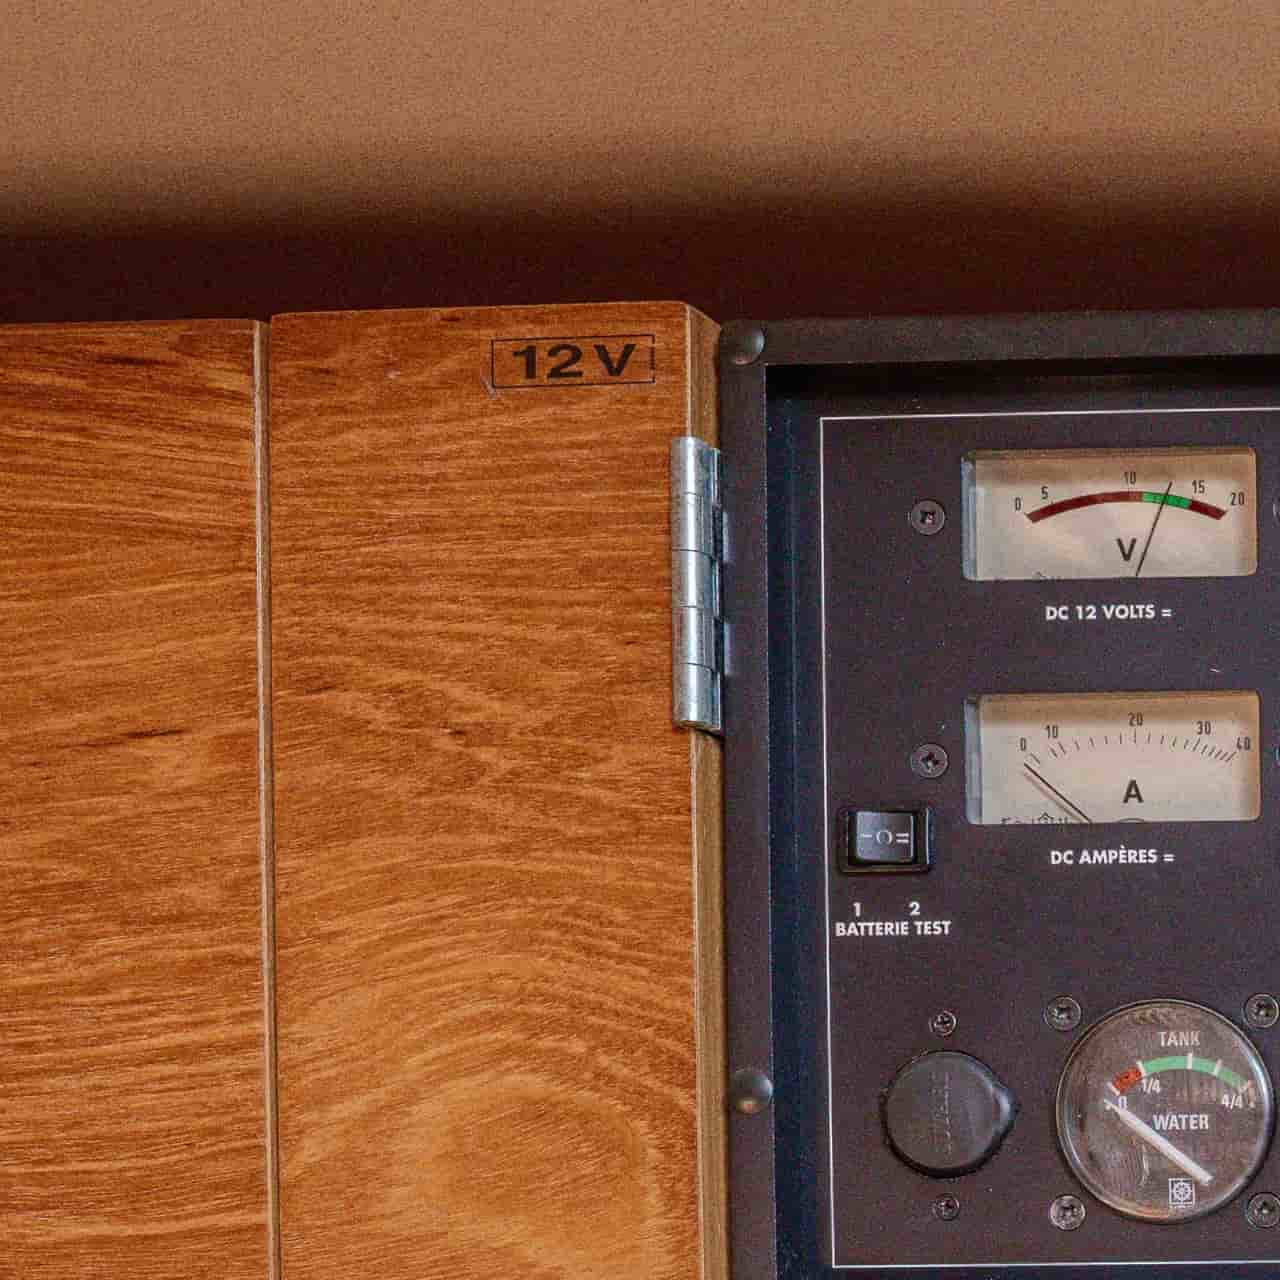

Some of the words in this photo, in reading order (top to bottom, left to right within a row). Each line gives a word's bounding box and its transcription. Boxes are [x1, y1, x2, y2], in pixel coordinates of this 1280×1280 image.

[512, 343, 637, 379] 12V
[1192, 480, 1206, 494] 15
[1230, 493, 1245, 507] 20
[1117, 538, 1137, 561] V
[1045, 606, 1068, 620] DC
[1076, 605, 1097, 620] 12
[1102, 604, 1155, 620] VOLTS
[1046, 725, 1058, 738] 10
[1128, 713, 1143, 726] 20
[1197, 721, 1211, 734] 30
[1123, 780, 1144, 803] A
[1050, 850, 1075, 865] DC
[1080, 845, 1156, 865] AMPÈRES
[853, 903, 861, 917] 1
[909, 902, 920, 916] 2
[835, 921, 908, 937] BATTERIE
[914, 920, 951, 935] TEST
[1160, 1032, 1200, 1047] TANK
[1222, 1094, 1243, 1109] 4/4
[1153, 1114, 1209, 1130] WATER
